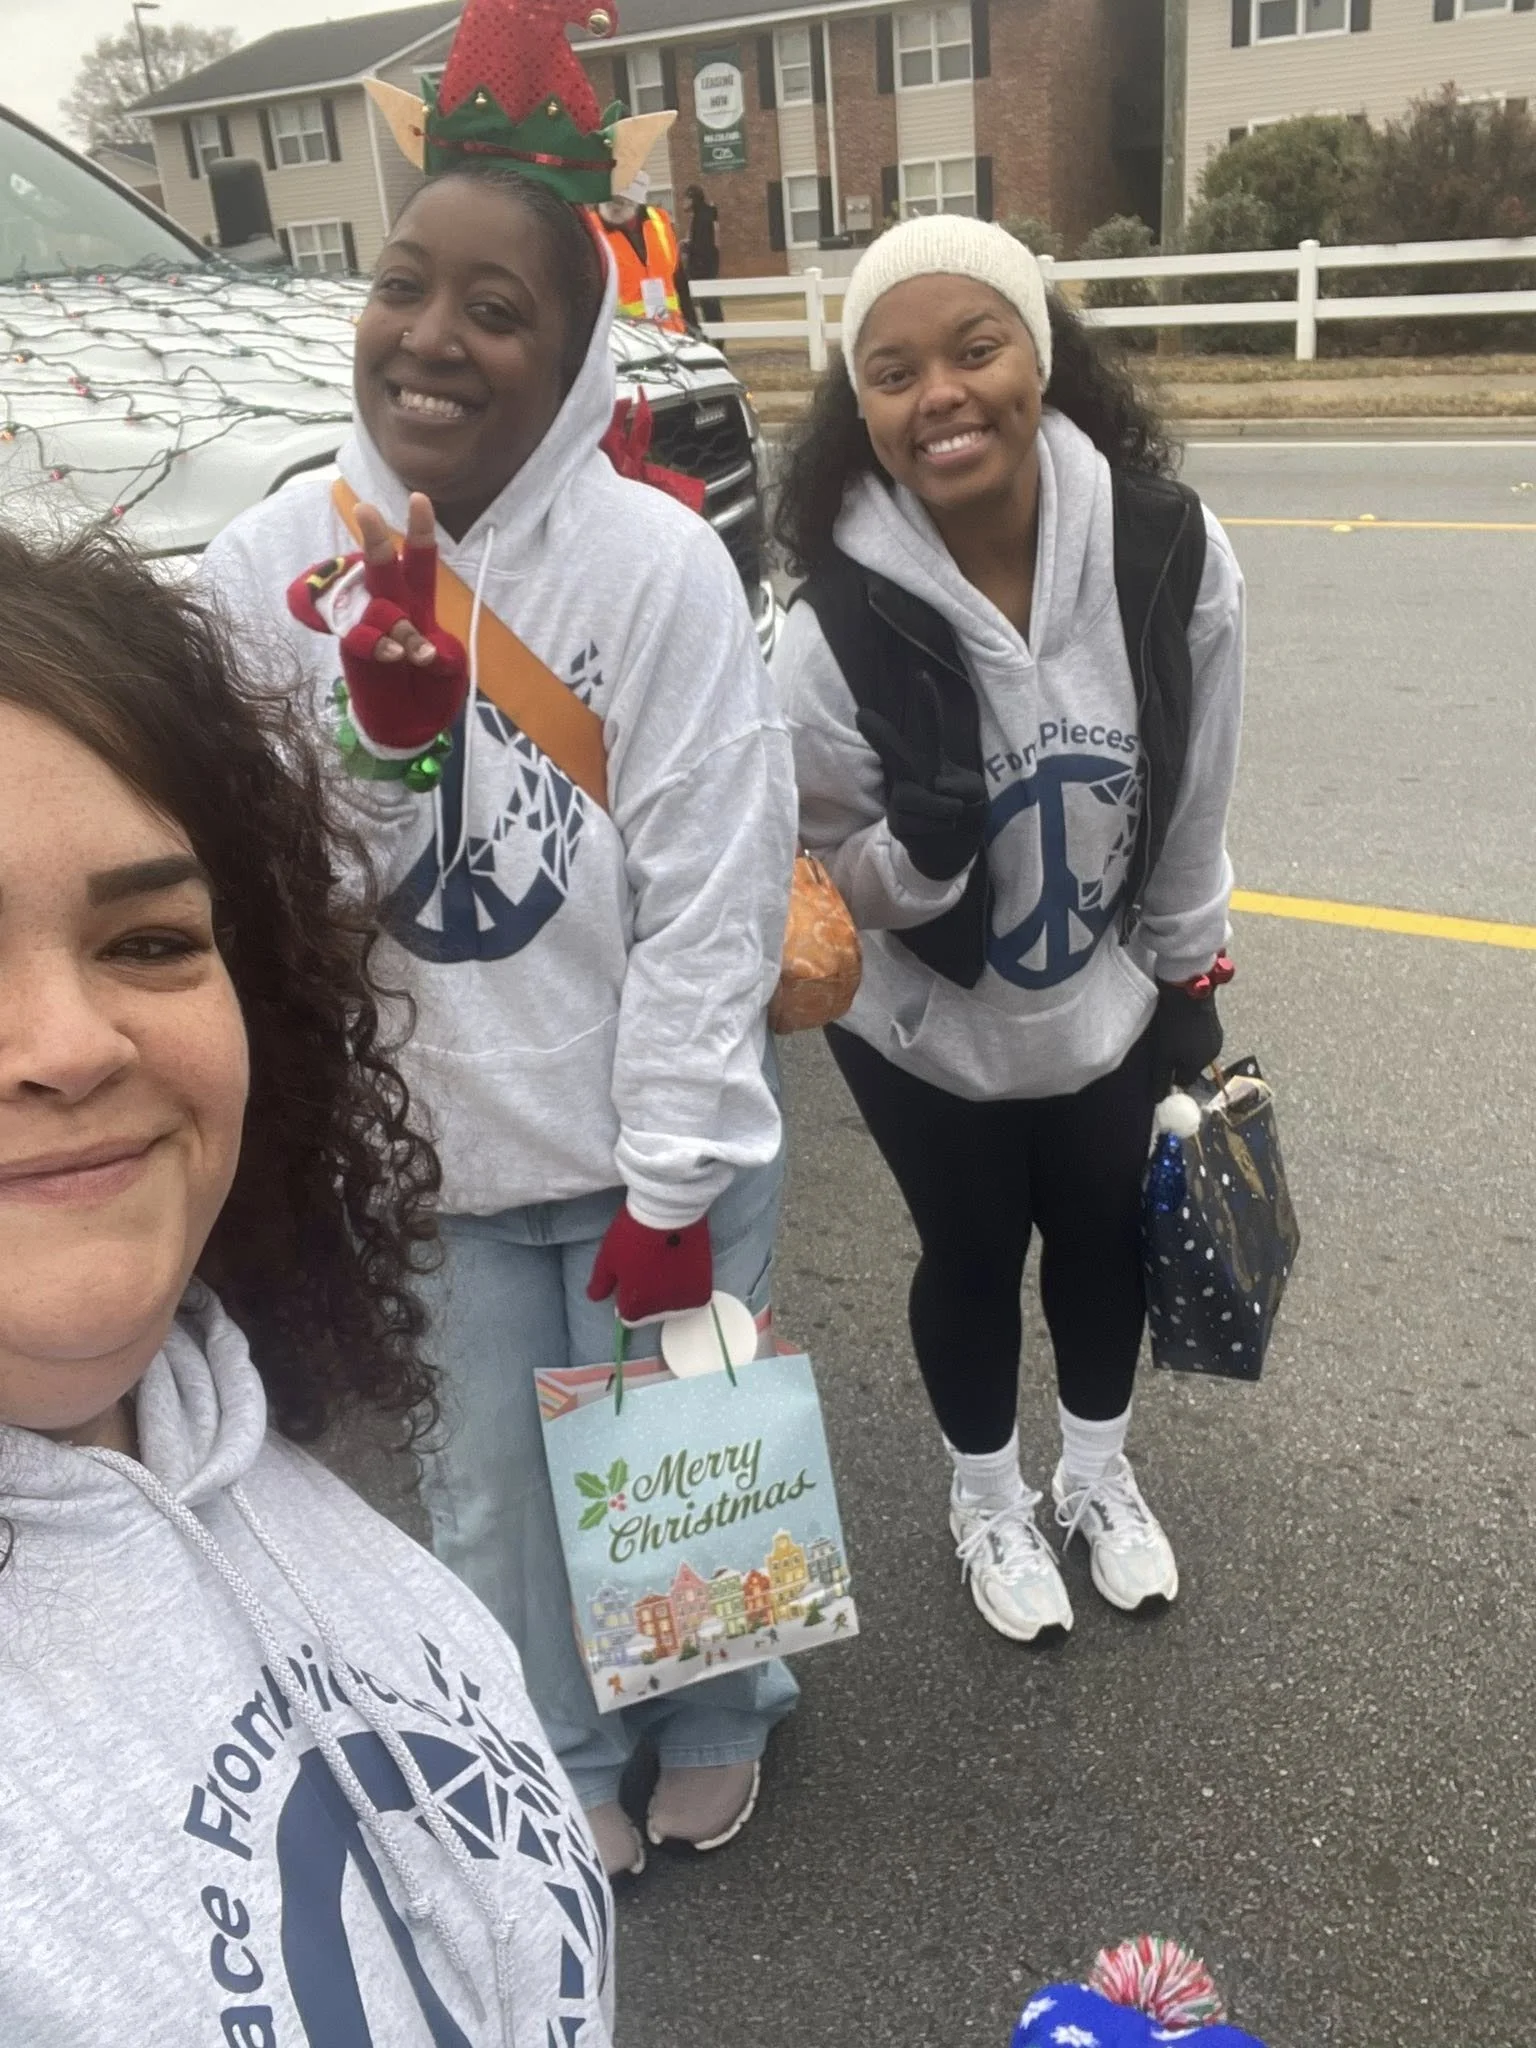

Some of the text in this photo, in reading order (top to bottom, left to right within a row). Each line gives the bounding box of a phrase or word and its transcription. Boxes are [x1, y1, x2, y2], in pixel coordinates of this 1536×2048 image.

[1039, 717, 1139, 753] Pieces
[631, 1437, 762, 1502] Merry
[608, 1468, 817, 1563] Christmas
